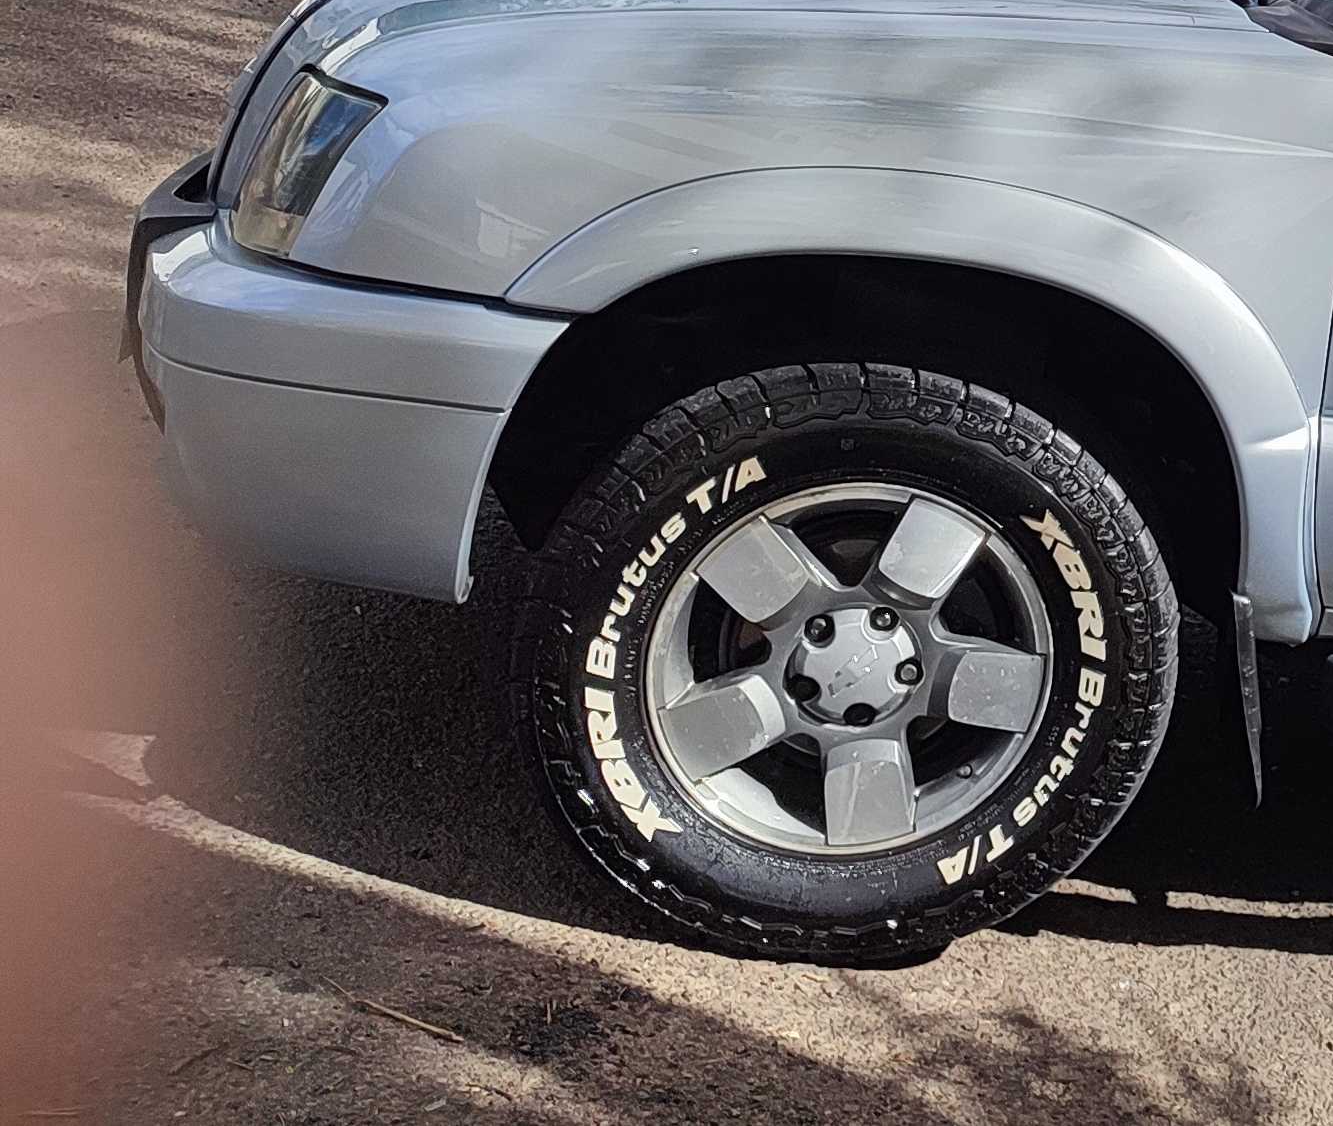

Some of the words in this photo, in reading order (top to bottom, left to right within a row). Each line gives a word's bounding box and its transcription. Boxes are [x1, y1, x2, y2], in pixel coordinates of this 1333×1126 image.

[686, 455, 767, 512] T/A
[586, 510, 687, 678] Brutus
[1021, 509, 1107, 662] XBRI
[584, 687, 683, 843] XBRI
[1012, 671, 1108, 826] Brutus
[936, 832, 1015, 885] T/A
